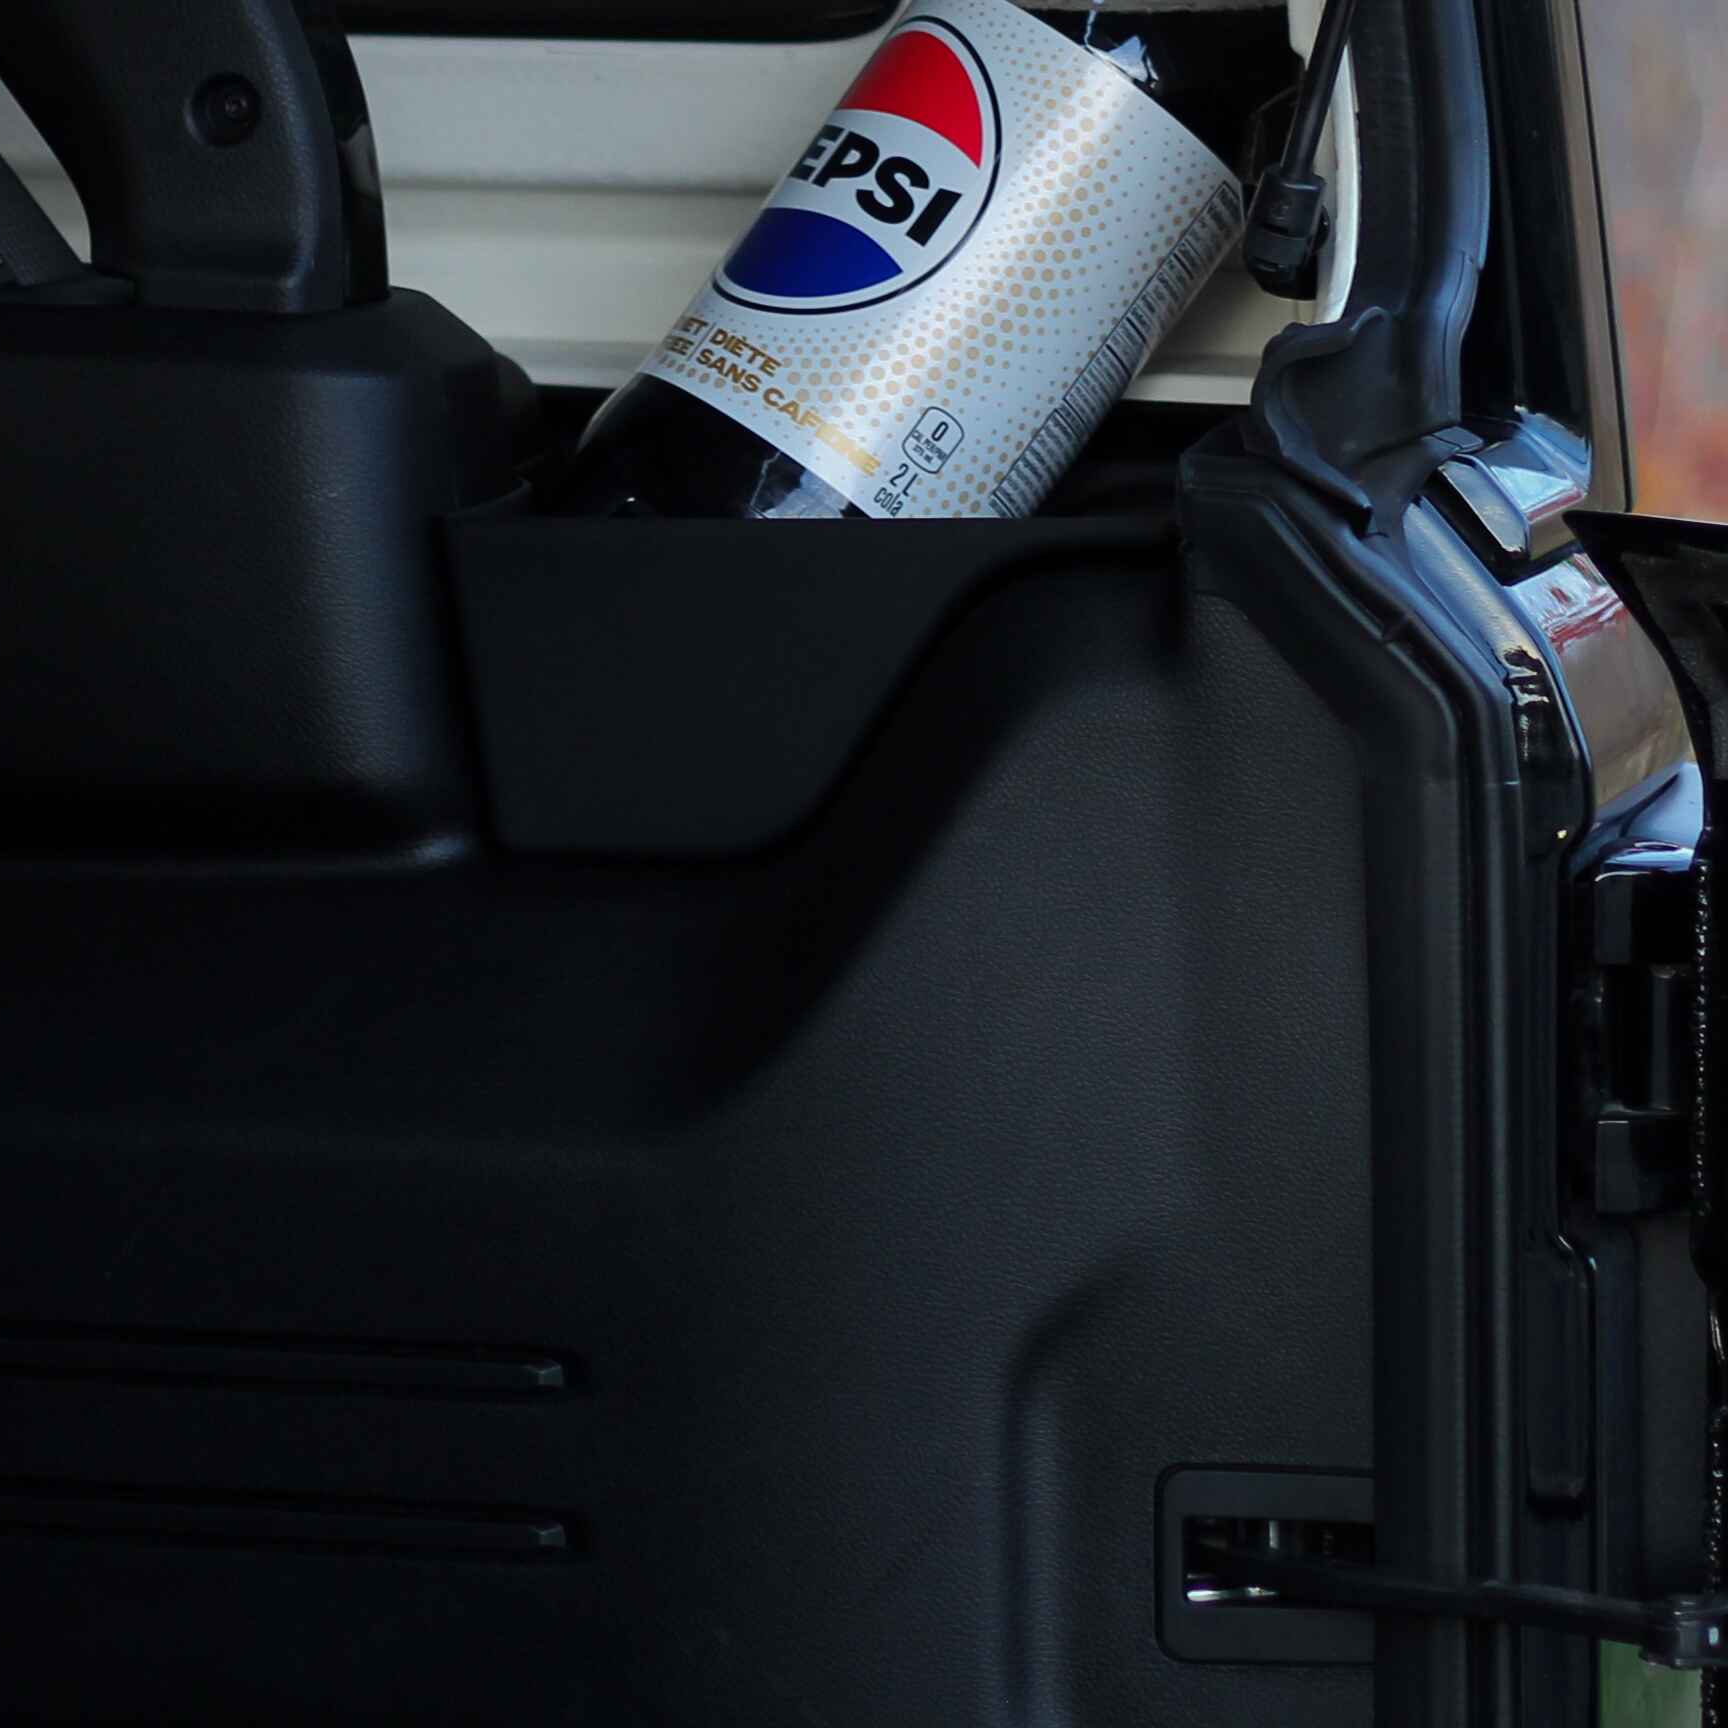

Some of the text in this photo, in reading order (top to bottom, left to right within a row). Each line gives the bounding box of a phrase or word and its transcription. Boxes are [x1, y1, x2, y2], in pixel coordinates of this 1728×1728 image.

[788, 124, 962, 246] EPSI
[696, 349, 762, 393] SANS
[709, 328, 782, 377] DIÈTE
[932, 421, 949, 441] 0
[890, 463, 918, 496] 2 L
[874, 487, 904, 517] cola
